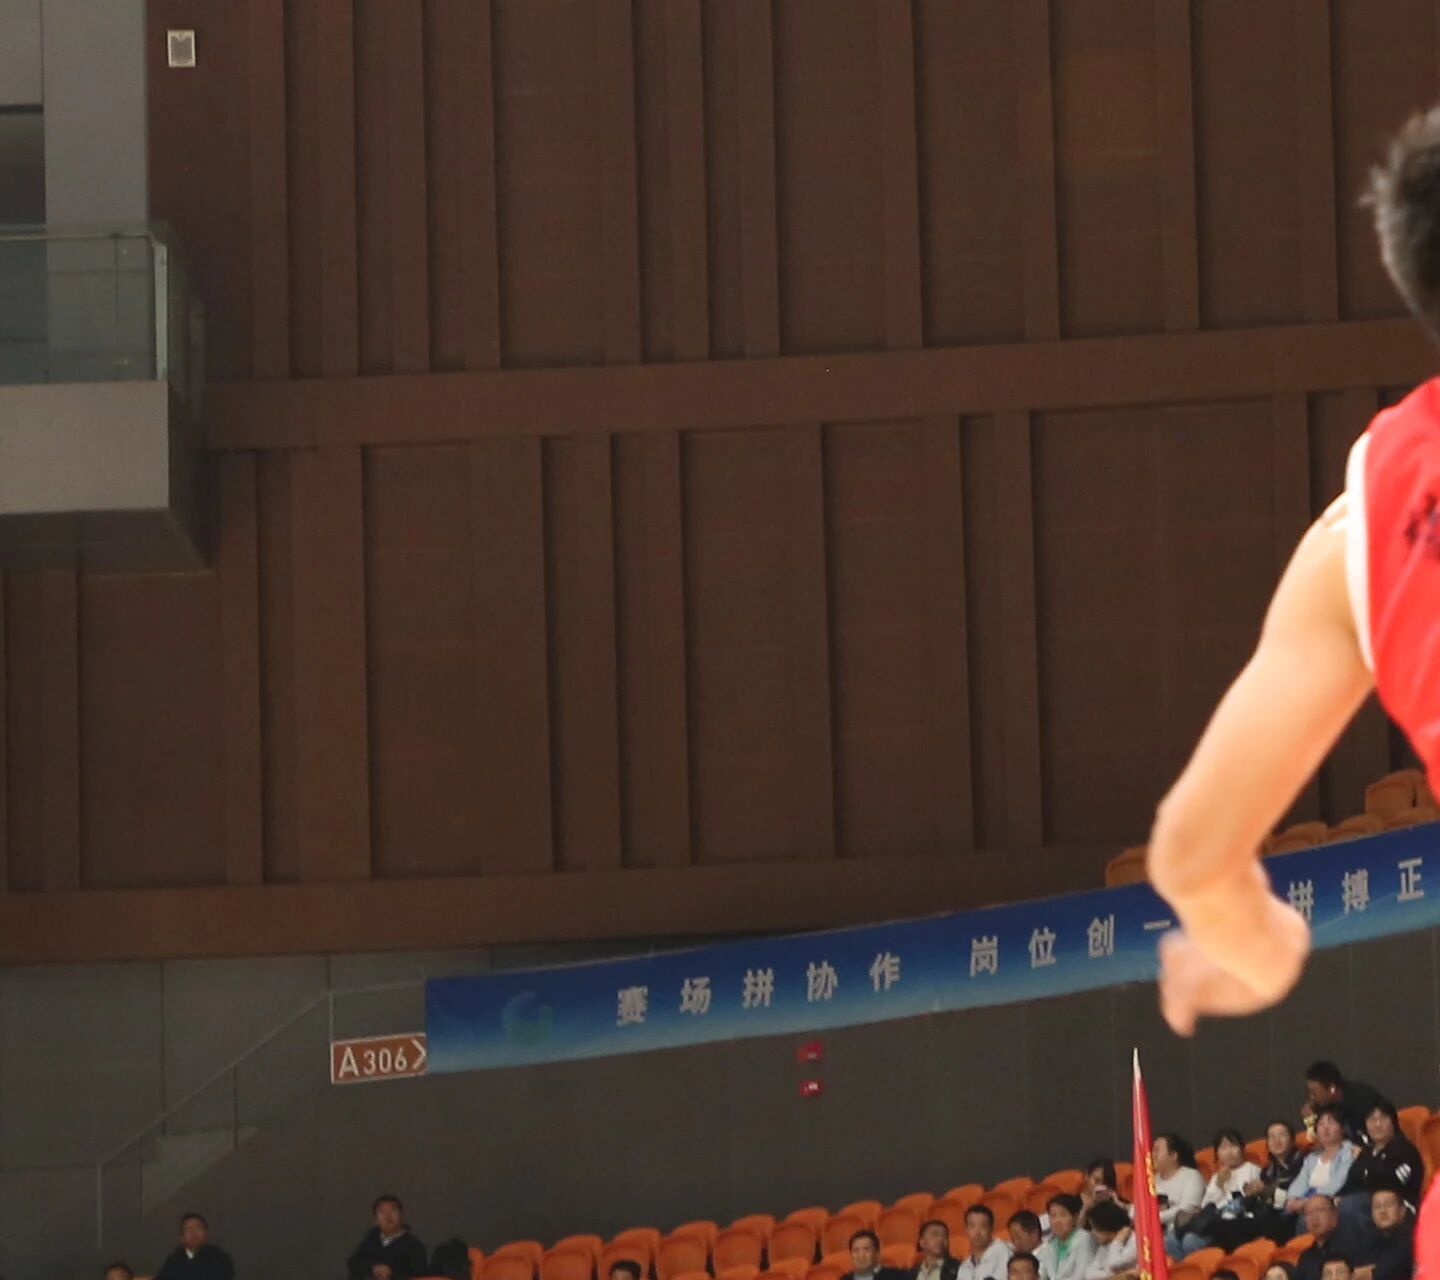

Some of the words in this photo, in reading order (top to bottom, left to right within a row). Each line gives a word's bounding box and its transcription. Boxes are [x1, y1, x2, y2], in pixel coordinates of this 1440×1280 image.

[616, 951, 902, 1027] 赛场拼协作
[338, 1045, 408, 1078] A306
